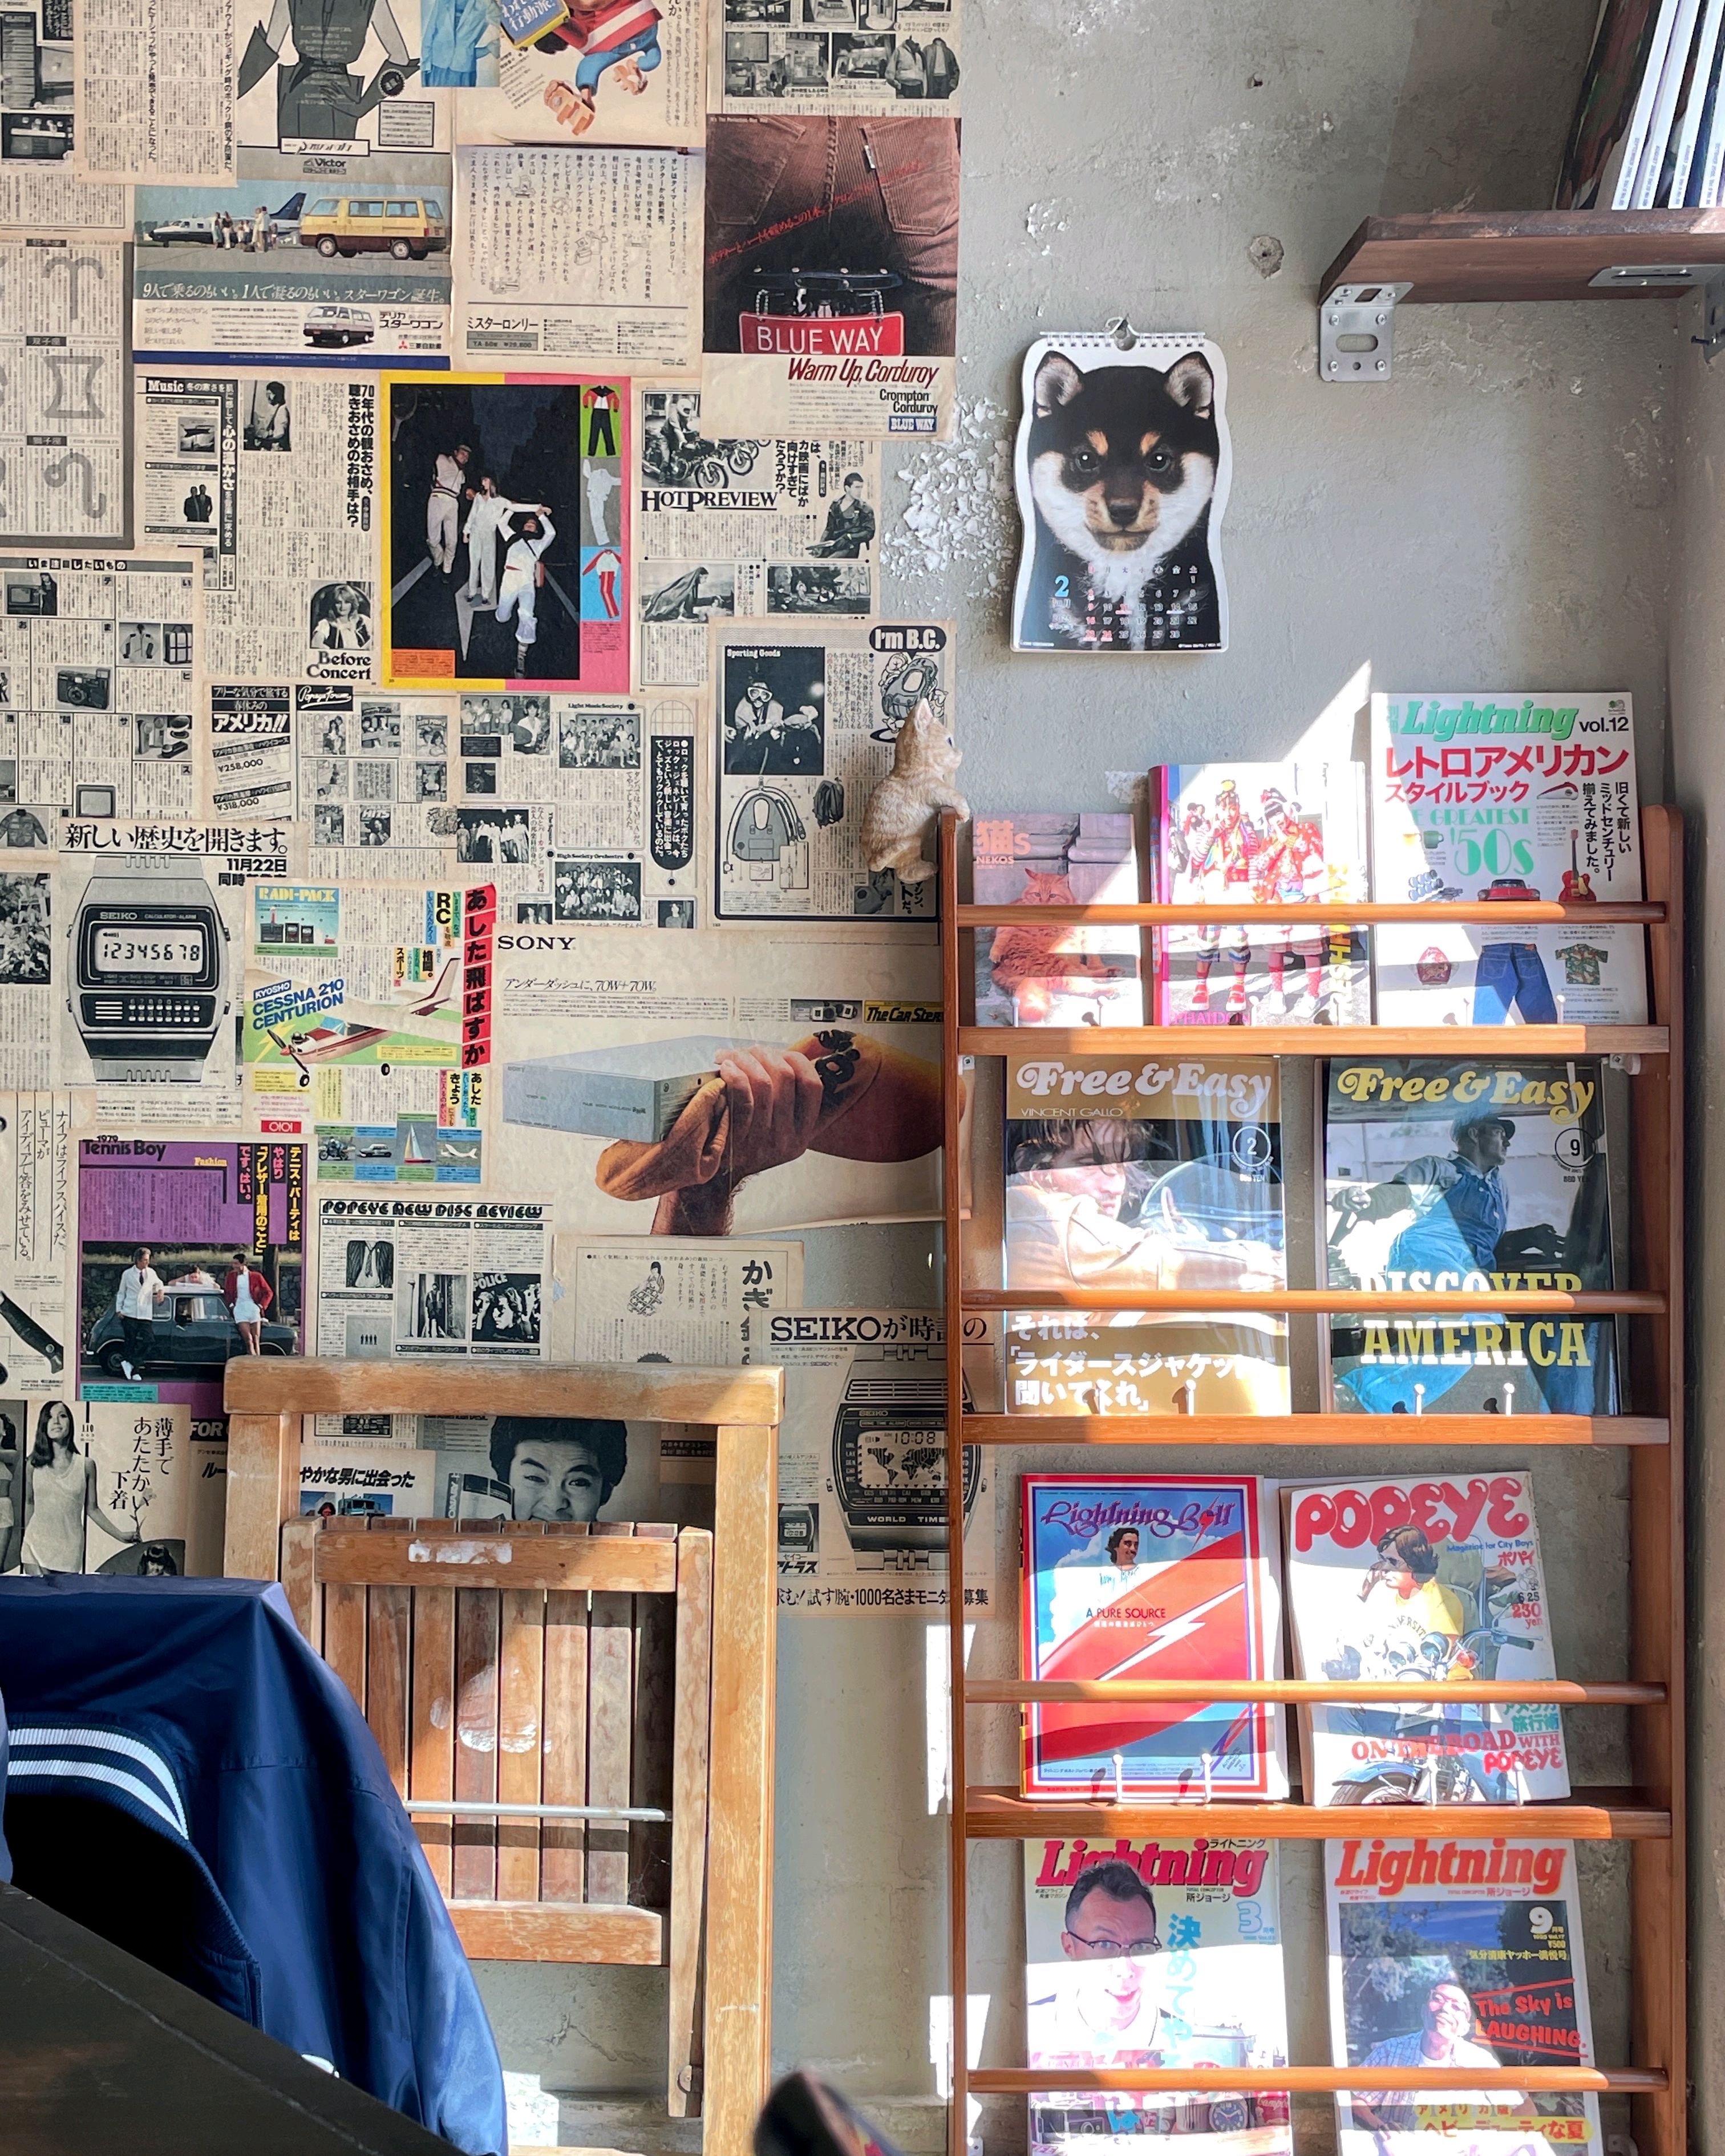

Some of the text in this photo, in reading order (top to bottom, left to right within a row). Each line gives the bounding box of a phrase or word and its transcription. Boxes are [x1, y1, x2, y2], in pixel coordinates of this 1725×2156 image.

[314, 157, 346, 167] Victor
[379, 321, 443, 330] スターワゴン
[467, 317, 539, 332] ミスターロンリー
[756, 326, 884, 355] BLUE WAY
[787, 358, 940, 389] Warm Up, Corduroy
[148, 379, 185, 392] Music
[879, 388, 930, 403] Crompton
[893, 400, 938, 416] Corduroy
[890, 418, 934, 432] BLUE WAY
[1055, 575, 1070, 597] 2
[874, 628, 941, 649] I'm B.C.
[318, 651, 371, 667] Before
[727, 649, 781, 659] Sporting Goods
[306, 665, 372, 680] Concert
[213, 714, 289, 732] アメリカ!!
[1400, 699, 1629, 741] Lightning vol.12
[218, 758, 264, 773] ¥258,000
[1386, 744, 1630, 779] レトロアメリカン
[1384, 781, 1529, 804] スタイルブック
[217, 797, 260, 810] ¥318,000
[1430, 807, 1530, 825] GREATEST
[1615, 781, 1631, 853] 旧くて新しい
[1582, 782, 1601, 874] 揃えてみました。
[1600, 782, 1616, 882] ミッドセンチュリー
[64, 824, 289, 855] 新しい歴史を開きます。
[976, 856, 1015, 865] NEKOS
[1449, 828, 1534, 876] '50s
[226, 858, 287, 873] 11月22日
[436, 892, 451, 925] RC
[103, 942, 200, 961] 12345678
[497, 935, 576, 950] SONY
[396, 947, 404, 979] スポーツ
[464, 887, 489, 1065] あした飛ばすか
[253, 978, 345, 1016] CESSNA 210
[256, 982, 290, 999] KYOSHO
[253, 992, 343, 1030] CENTURION
[866, 1006, 910, 1022] The Car
[1175, 1011, 1252, 1026] PHAIDON
[450, 1073, 461, 1105] きょう
[471, 1072, 482, 1105] あした
[1015, 1061, 1272, 1119] Free & Easy
[1337, 1067, 1595, 1125] Free & Easy
[1021, 1107, 1124, 1117] VINCENT GALLO
[36, 1110, 51, 1160] ピューマが
[83, 1139, 167, 1161] Tennis Boy
[1246, 1137, 1257, 1156] 2
[1570, 1138, 1580, 1157] 9
[193, 1156, 228, 1166] Fashion
[272, 1146, 285, 1181] やはり
[239, 1145, 252, 1201] です、はい。
[19, 1109, 34, 1262] アイディアで答をみせている。
[322, 1200, 543, 1219] POPEYE NEW DISC REVIEW
[473, 1274, 508, 1292] POLICE
[1011, 1315, 1100, 1341] それは、
[1360, 1320, 1592, 1367] AMERICA
[82, 1424, 94, 1433] 110
[191, 1422, 222, 1437] FOR
[894, 1431, 936, 1445] 10:08
[154, 1417, 175, 1476] 薄手で
[131, 1416, 152, 1511] あたたかい
[299, 1466, 415, 1488] やかな男に出会った
[108, 1470, 131, 1510] 下着
[1040, 1500, 1174, 1539] Lightning
[1295, 1477, 1529, 1553] POPEYE
[1446, 1543, 1484, 1553] Magazine
[1497, 1541, 1514, 1550] City
[1515, 1539, 1534, 1550] Boys
[1497, 1551, 1534, 1567] ポパイ
[1526, 1591, 1540, 1603] 25
[1086, 1607, 1167, 1619] A PURE SOURCE
[1512, 1603, 1542, 1618] 230
[1525, 1618, 1543, 1631] yen
[1512, 1715, 1560, 1733] 旅行術
[1351, 1729, 1561, 1761] ON ROAD WITH
[1484, 1747, 1565, 1774] POPEYE
[1209, 1838, 1266, 1849] ライトニング
[1334, 1838, 1567, 1898] Lightning
[1186, 1892, 1231, 1903] 所ジョージ
[1486, 1887, 1531, 1898] 所ジョージ
[1236, 1900, 1263, 1934] 3
[1528, 1906, 1554, 1935] 9
[1547, 1940, 1566, 1948] ¥500
[1476, 1992, 1573, 2017] The Sky is
[1475, 2019, 1587, 2049] LAUGHING.
